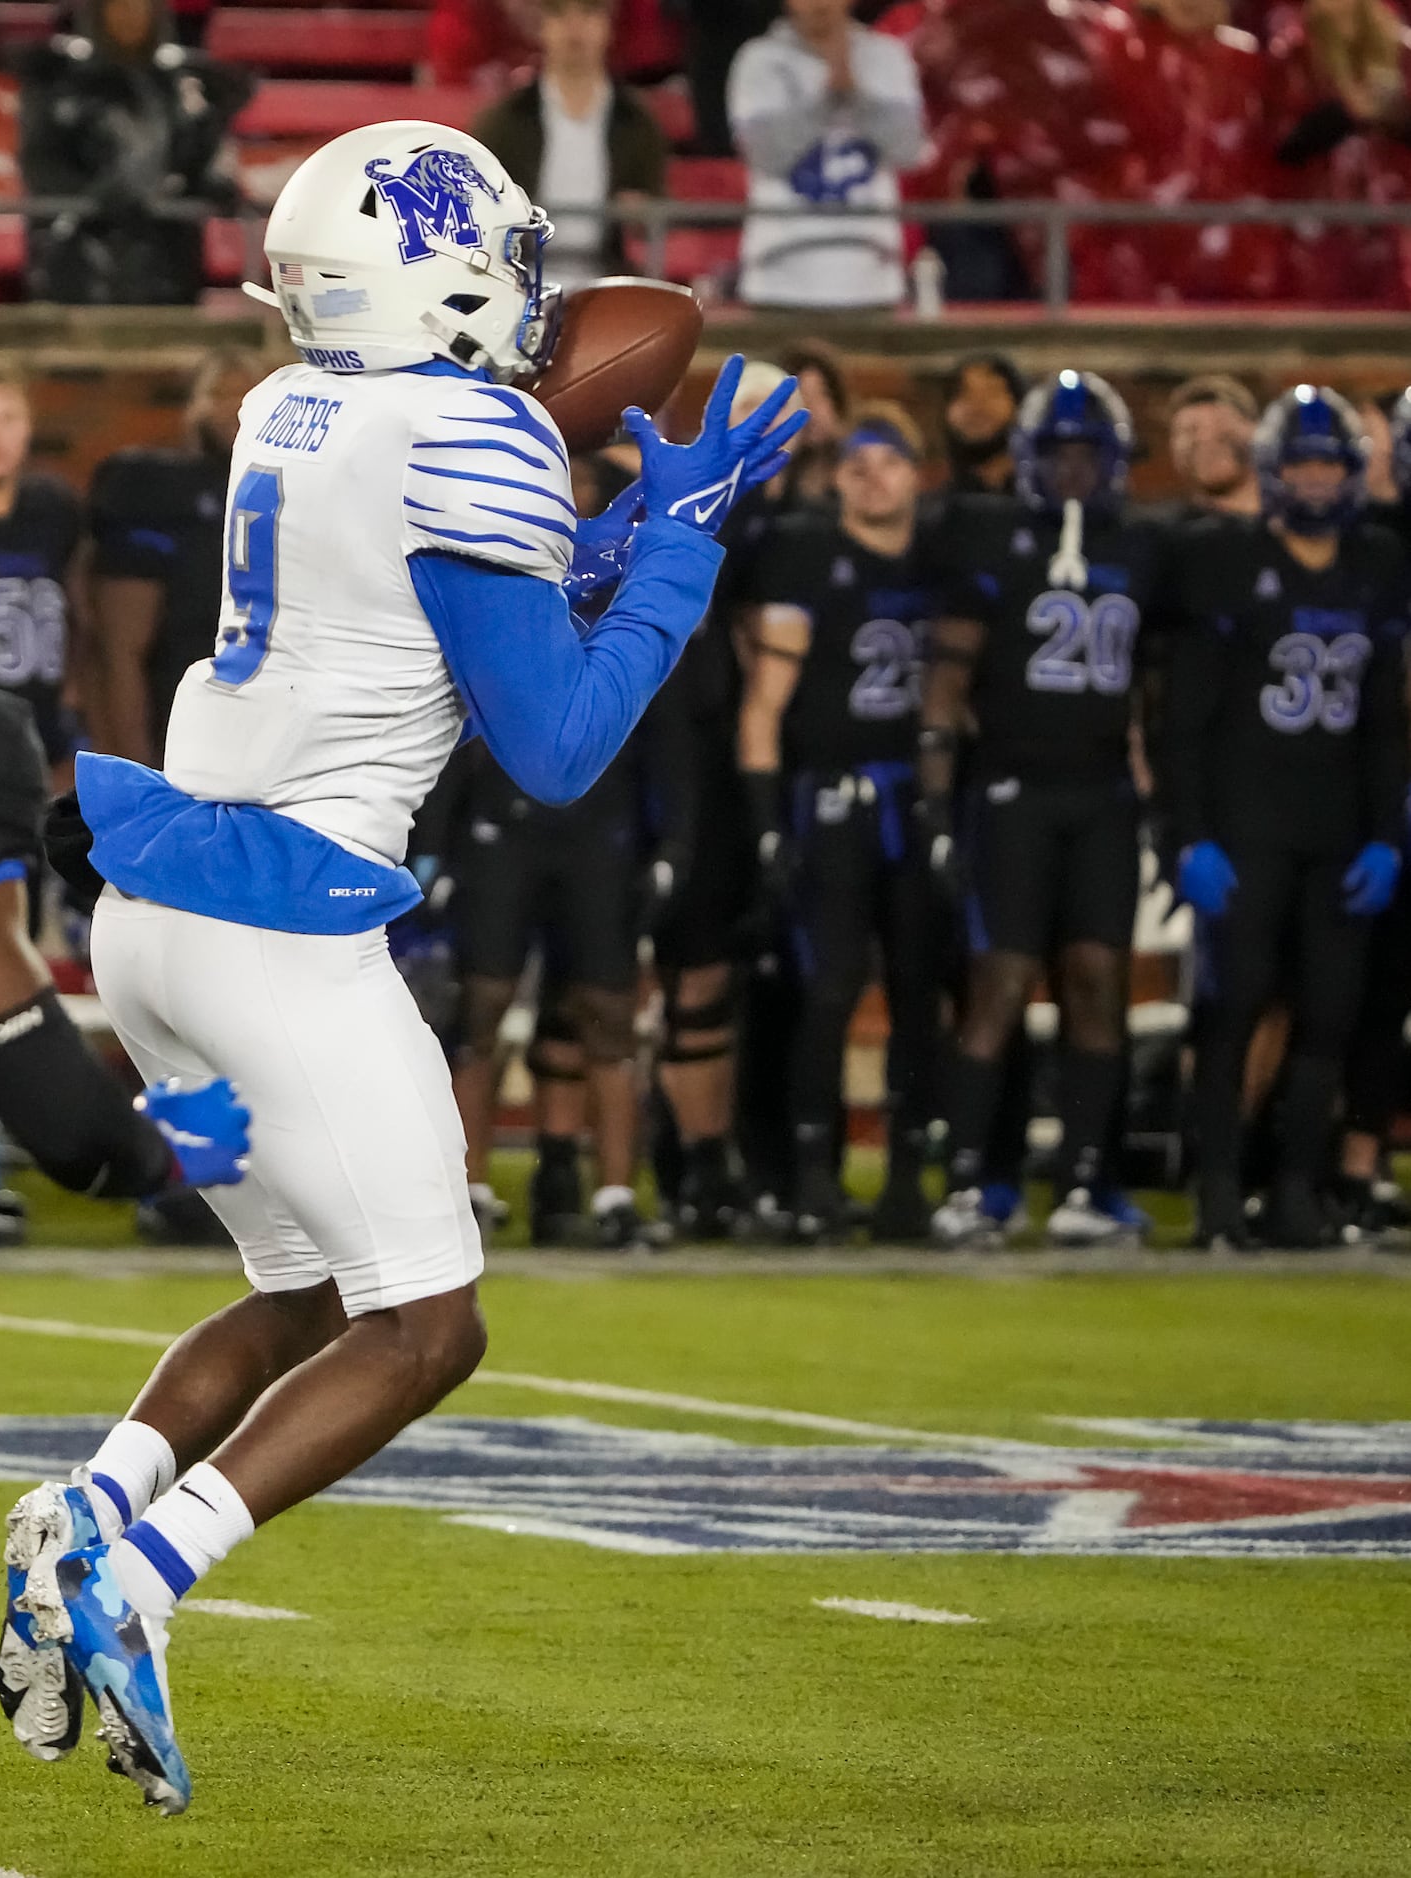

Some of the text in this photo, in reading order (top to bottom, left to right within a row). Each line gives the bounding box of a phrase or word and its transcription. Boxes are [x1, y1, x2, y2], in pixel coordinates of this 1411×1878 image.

[256, 393, 343, 452] ROGERS
[204, 462, 285, 692] 9
[1026, 589, 1140, 698] 20
[329, 887, 377, 897] DRI-FIT
